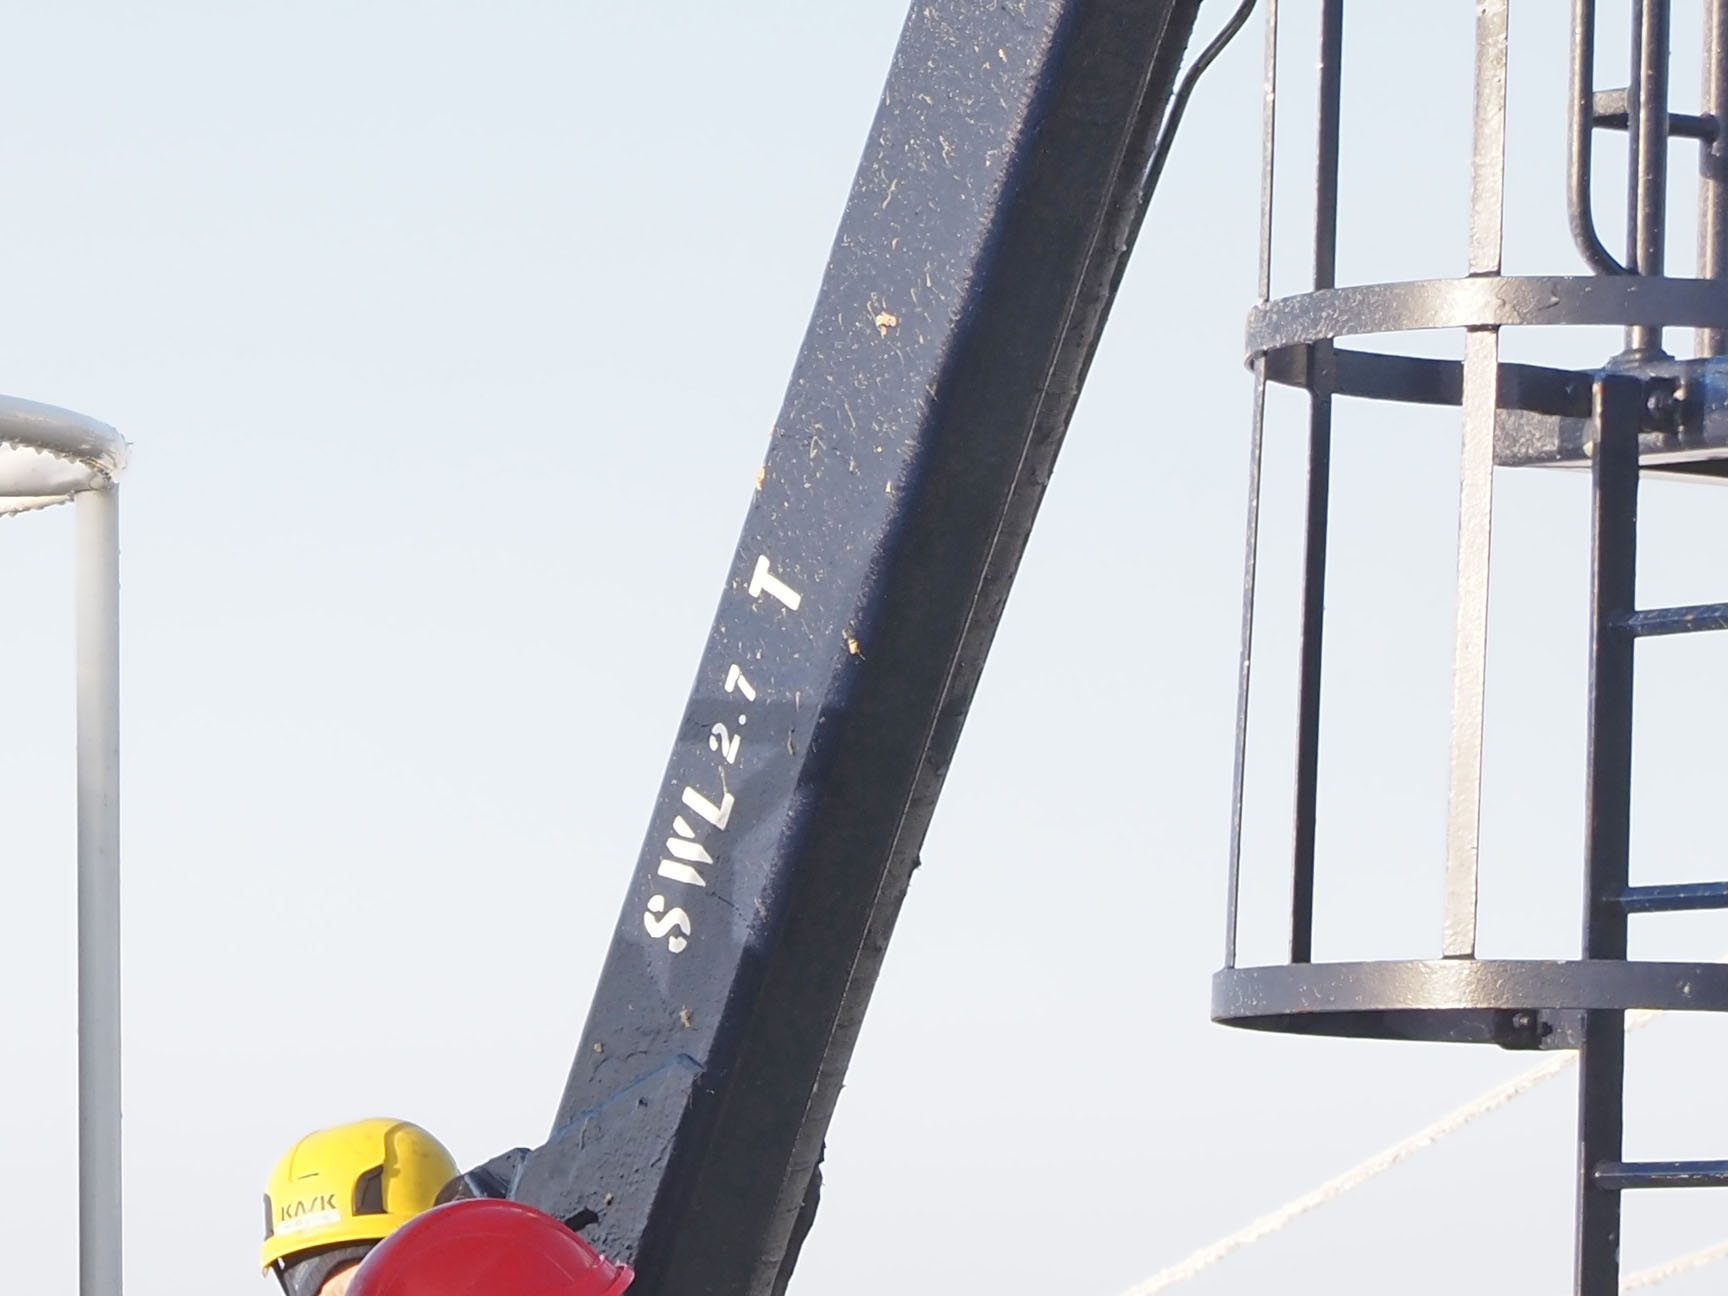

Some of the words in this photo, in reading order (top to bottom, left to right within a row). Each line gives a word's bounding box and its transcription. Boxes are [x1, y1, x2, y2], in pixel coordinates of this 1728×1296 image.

[709, 663, 757, 764] 2.7
[748, 554, 802, 611] T
[281, 1193, 337, 1221] KASK
